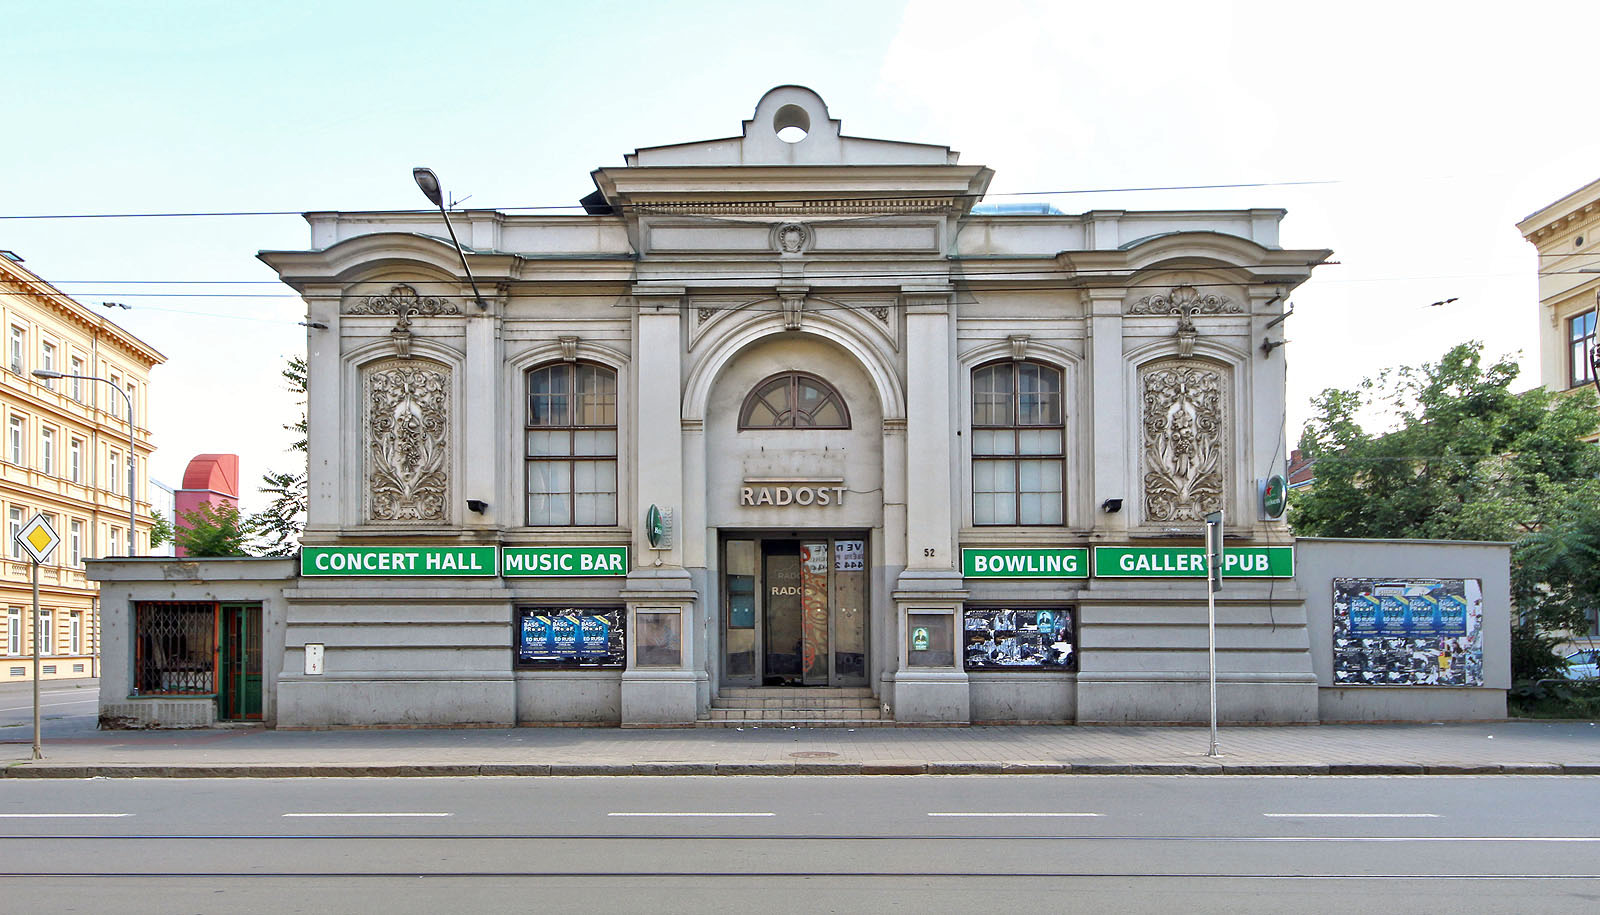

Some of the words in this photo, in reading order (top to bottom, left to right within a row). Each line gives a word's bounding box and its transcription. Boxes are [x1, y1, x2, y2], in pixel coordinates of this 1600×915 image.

[740, 486, 848, 506] RADOST
[924, 548, 935, 557] 52
[315, 553, 419, 570] CONCERT
[426, 553, 482, 570] HALL
[505, 554, 573, 571] MUSIC
[580, 554, 623, 570] BAR
[974, 555, 1077, 572] BOWLING
[1119, 554, 1208, 571] GALLER
[1225, 554, 1269, 571] PUB
